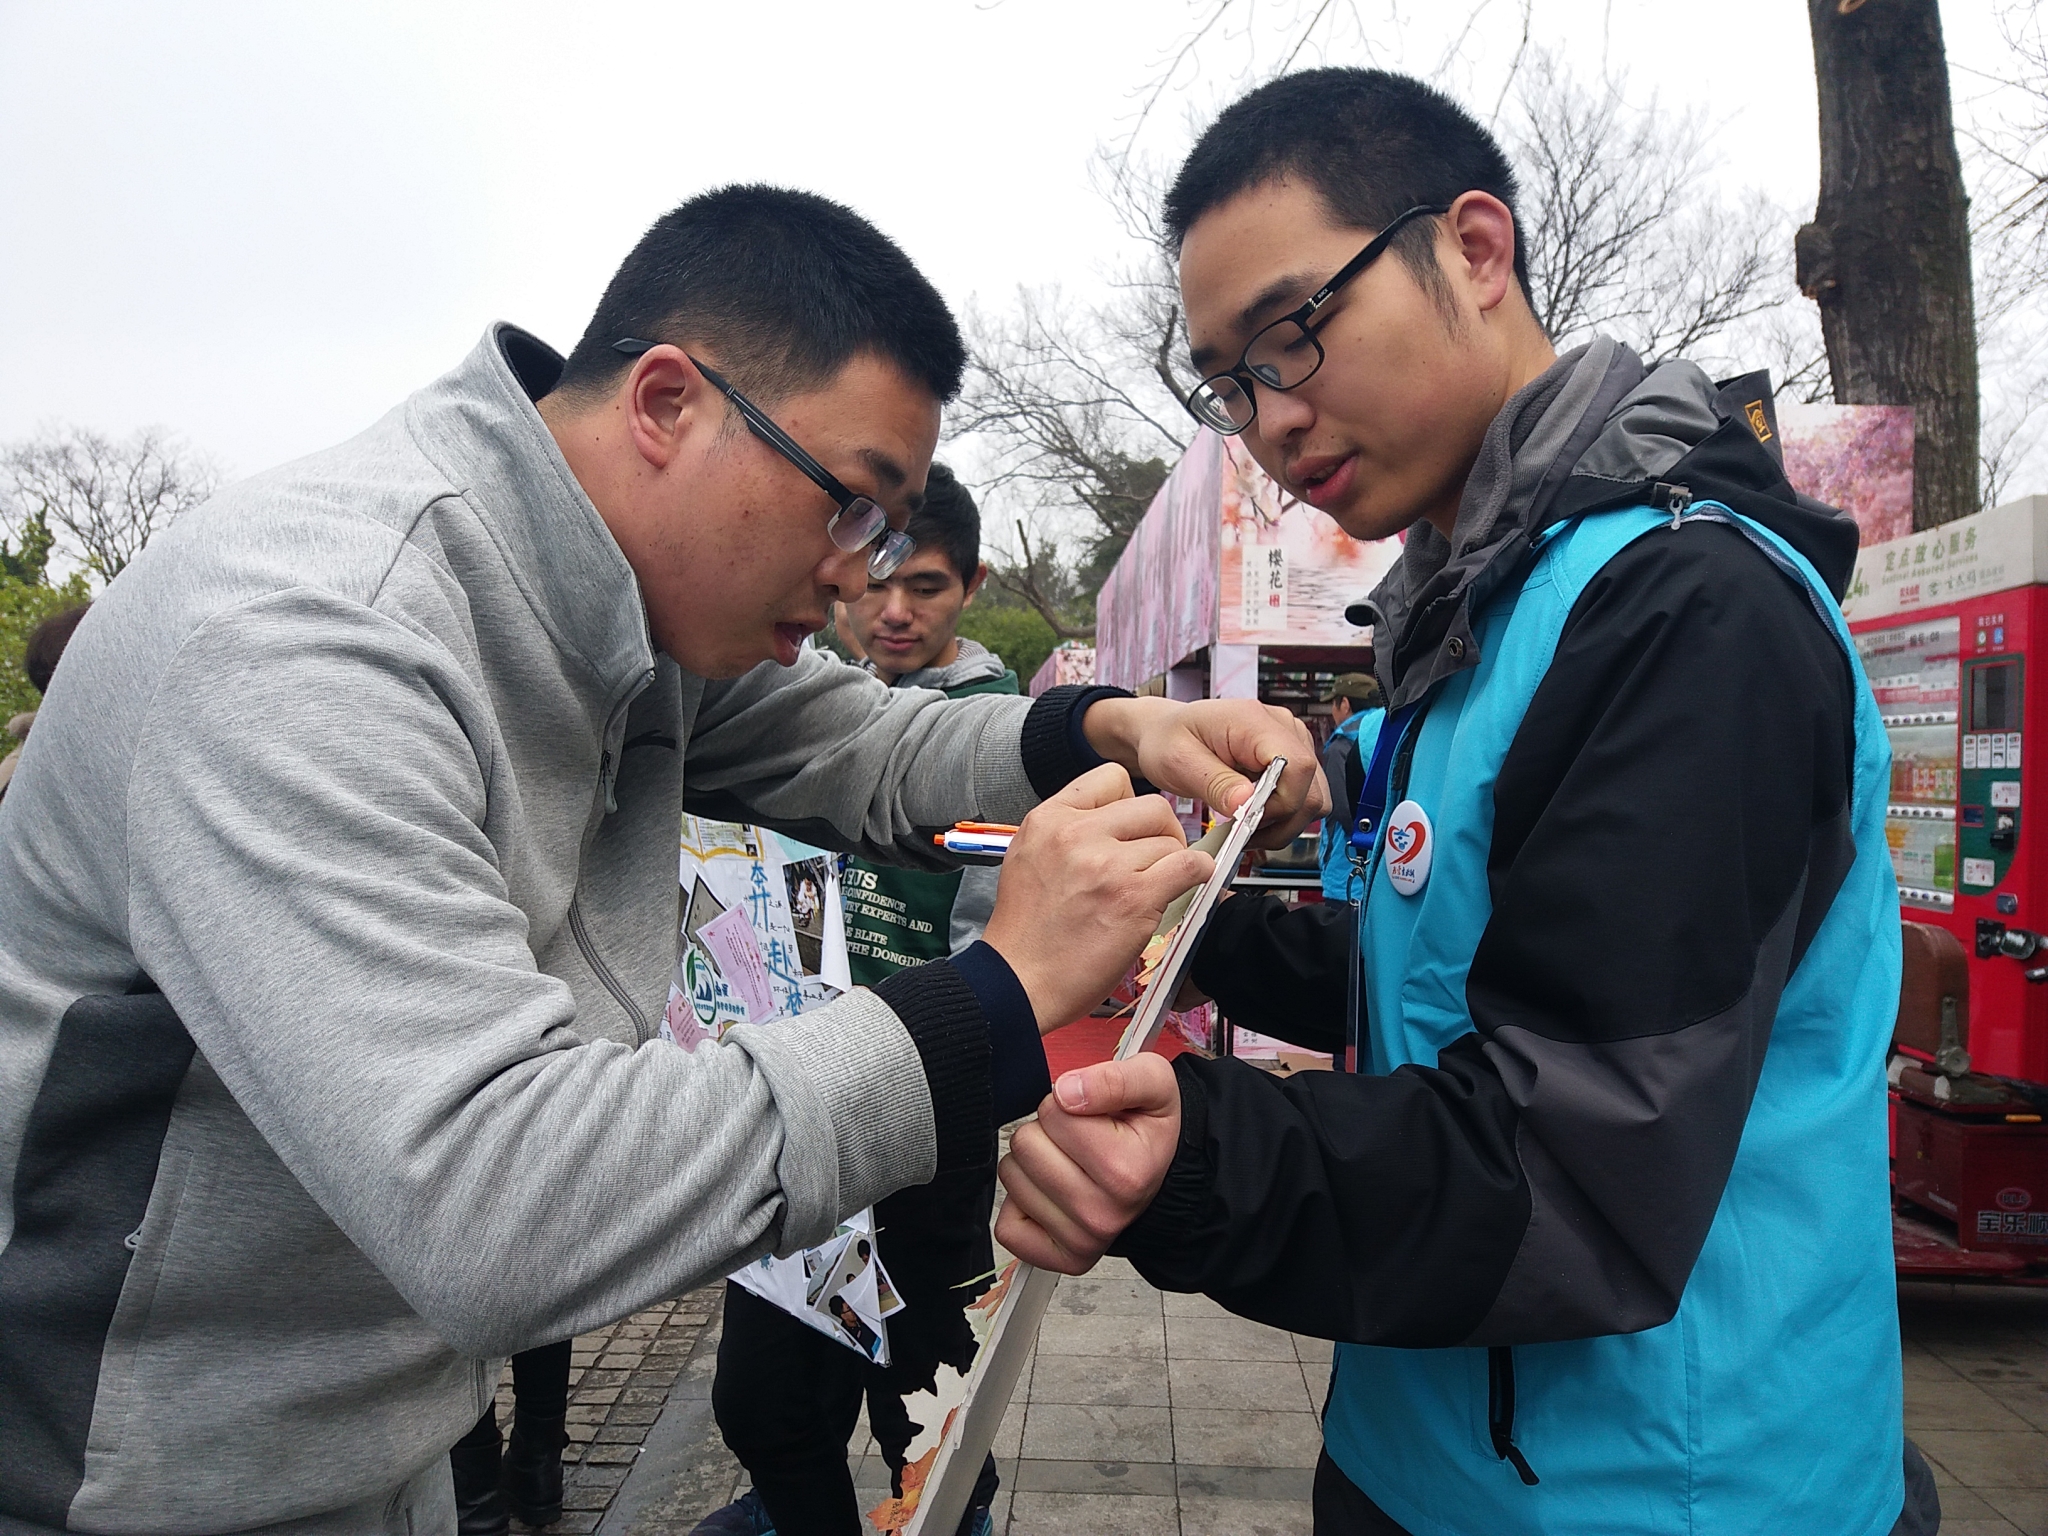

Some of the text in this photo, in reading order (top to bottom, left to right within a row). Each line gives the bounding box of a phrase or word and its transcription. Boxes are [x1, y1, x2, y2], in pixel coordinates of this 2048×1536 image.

[860, 903, 907, 927] EXPERTS
[908, 919, 933, 933] AND
[1977, 1210, 2048, 1235] 宝乐顺
